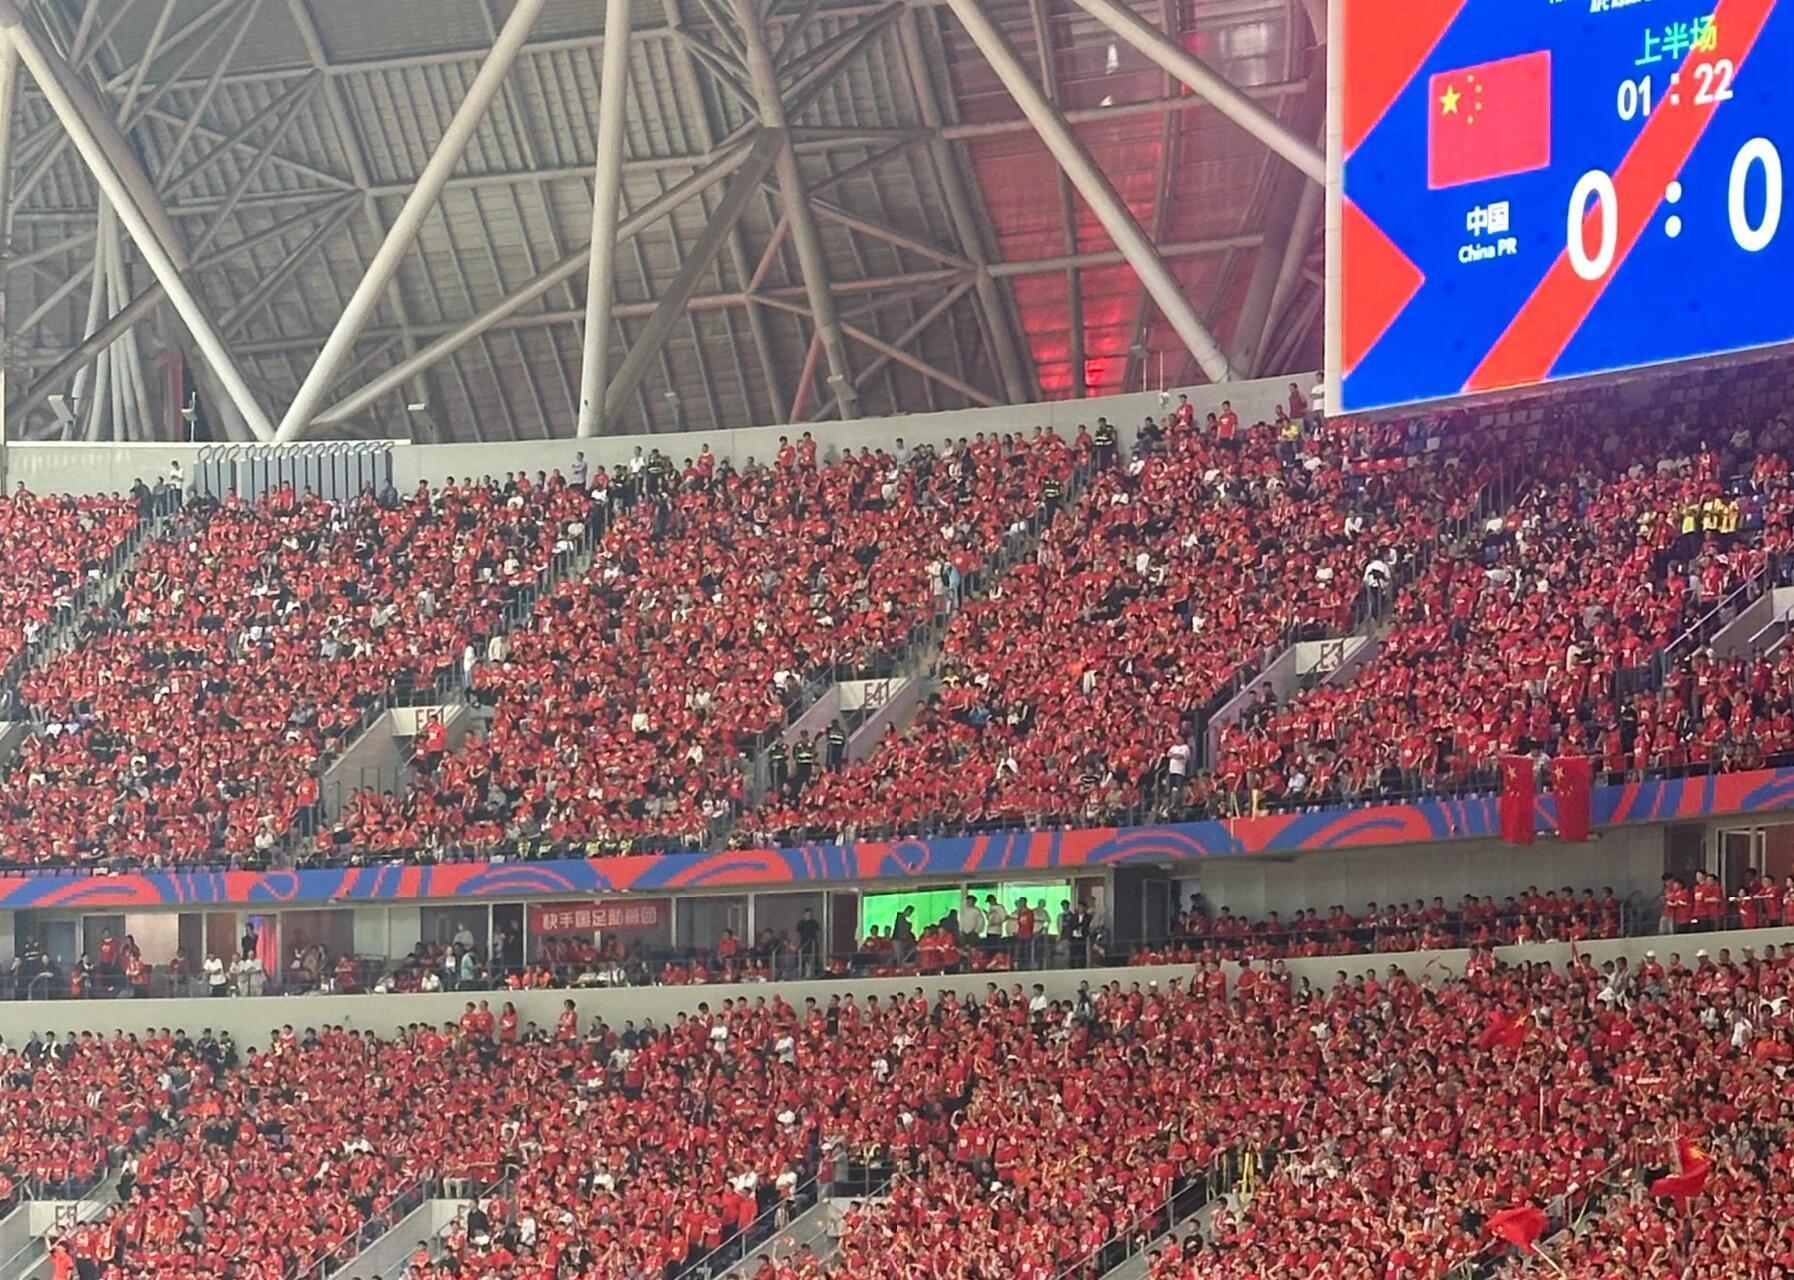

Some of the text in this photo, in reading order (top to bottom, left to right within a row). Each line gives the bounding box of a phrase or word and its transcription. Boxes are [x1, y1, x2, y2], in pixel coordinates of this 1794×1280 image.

[1634, 14, 1718, 66] 上半场
[1466, 200, 1510, 237] 中国
[1458, 237, 1518, 264] China PR
